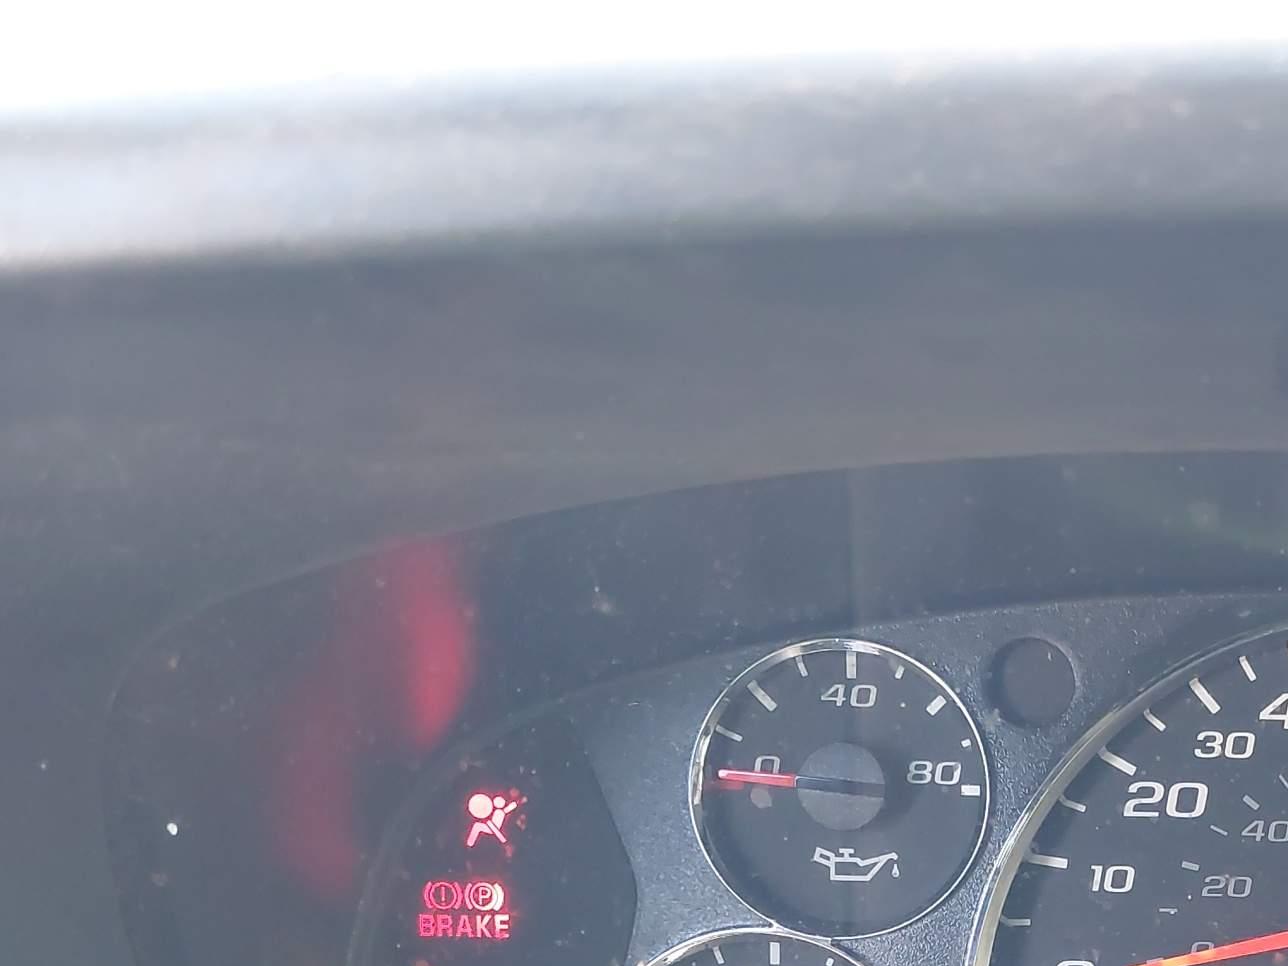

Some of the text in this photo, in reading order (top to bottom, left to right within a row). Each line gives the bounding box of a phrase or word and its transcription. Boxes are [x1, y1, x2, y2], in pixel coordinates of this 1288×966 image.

[820, 684, 877, 707] 40
[1194, 731, 1256, 759] 30
[906, 761, 961, 785] 80
[1123, 782, 1209, 819] 20
[1090, 864, 1136, 893] 10
[1201, 875, 1252, 898] 20
[419, 913, 511, 939] BRAKE
